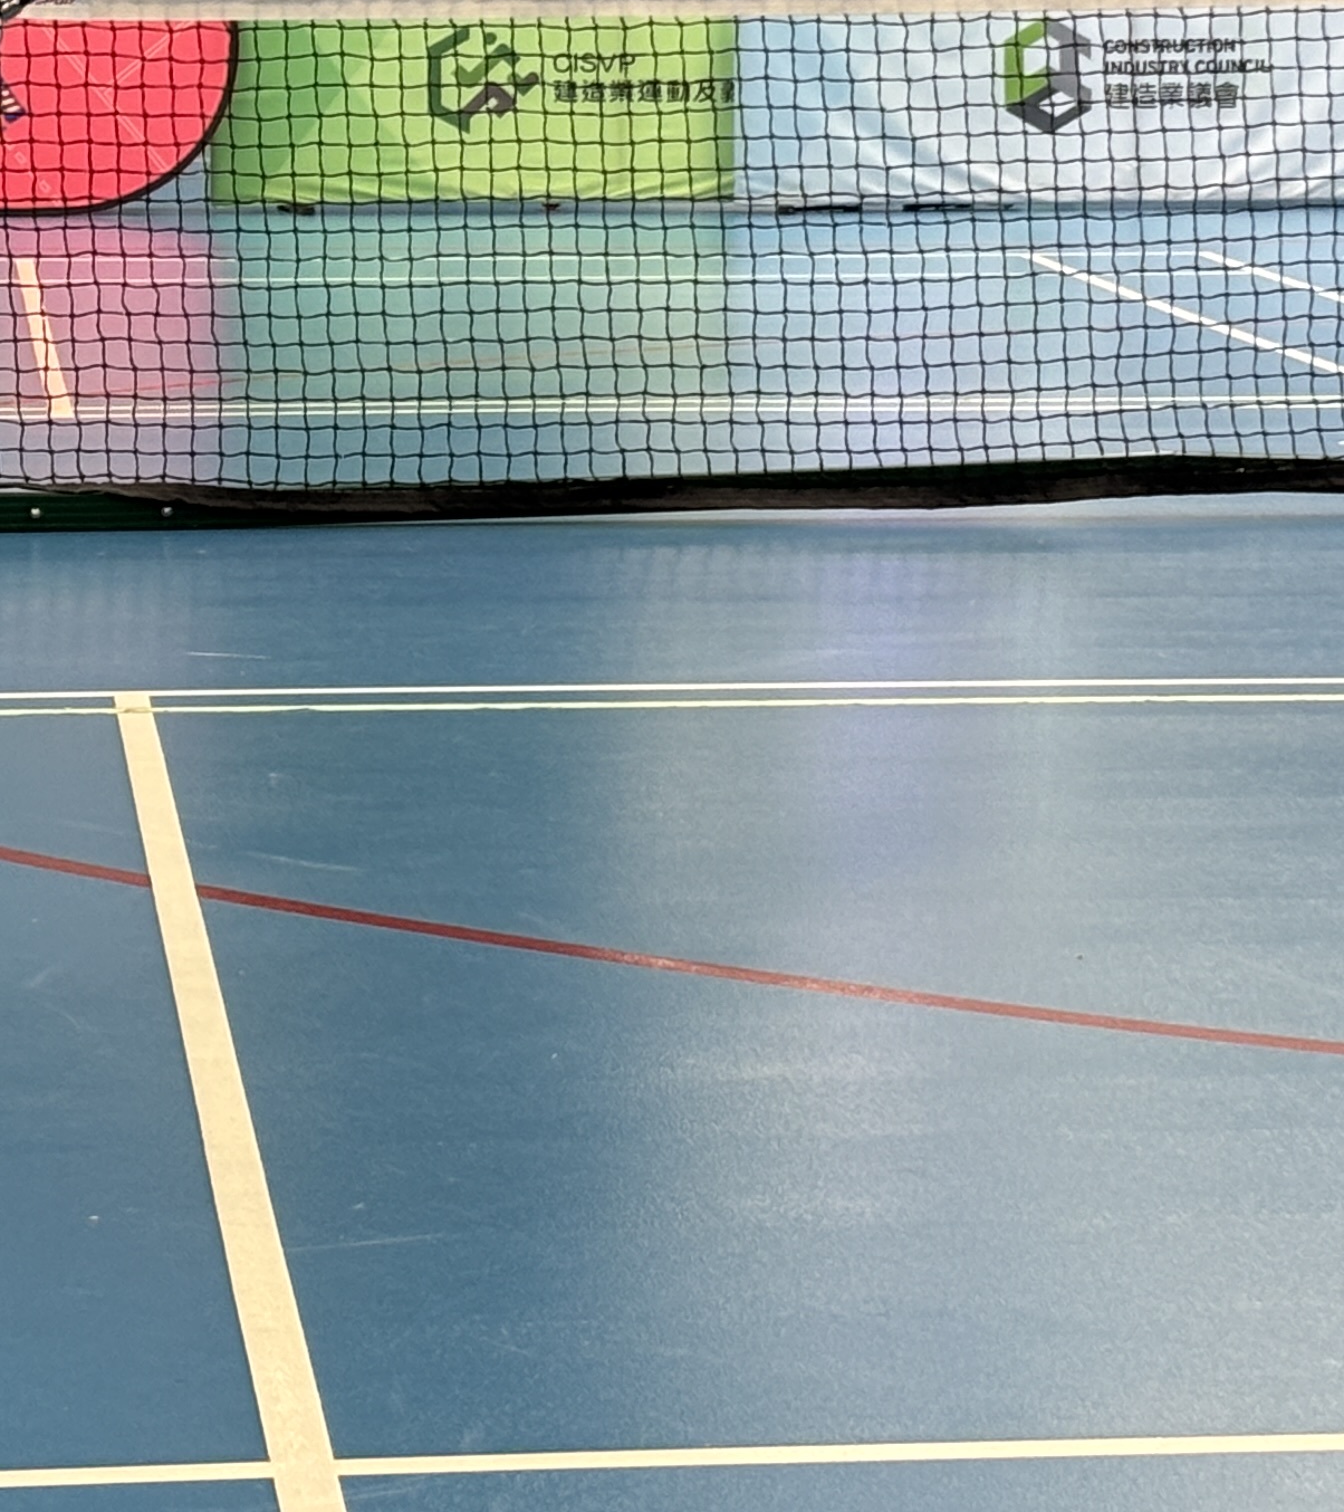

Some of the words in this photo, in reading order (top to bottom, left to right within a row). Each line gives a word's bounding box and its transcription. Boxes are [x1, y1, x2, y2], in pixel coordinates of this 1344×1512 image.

[1104, 39, 1236, 54] CONSTRUCTION
[553, 53, 636, 74] CISVP
[1104, 59, 1189, 74] INDUSTRY
[1194, 58, 1271, 73] COUNCIL
